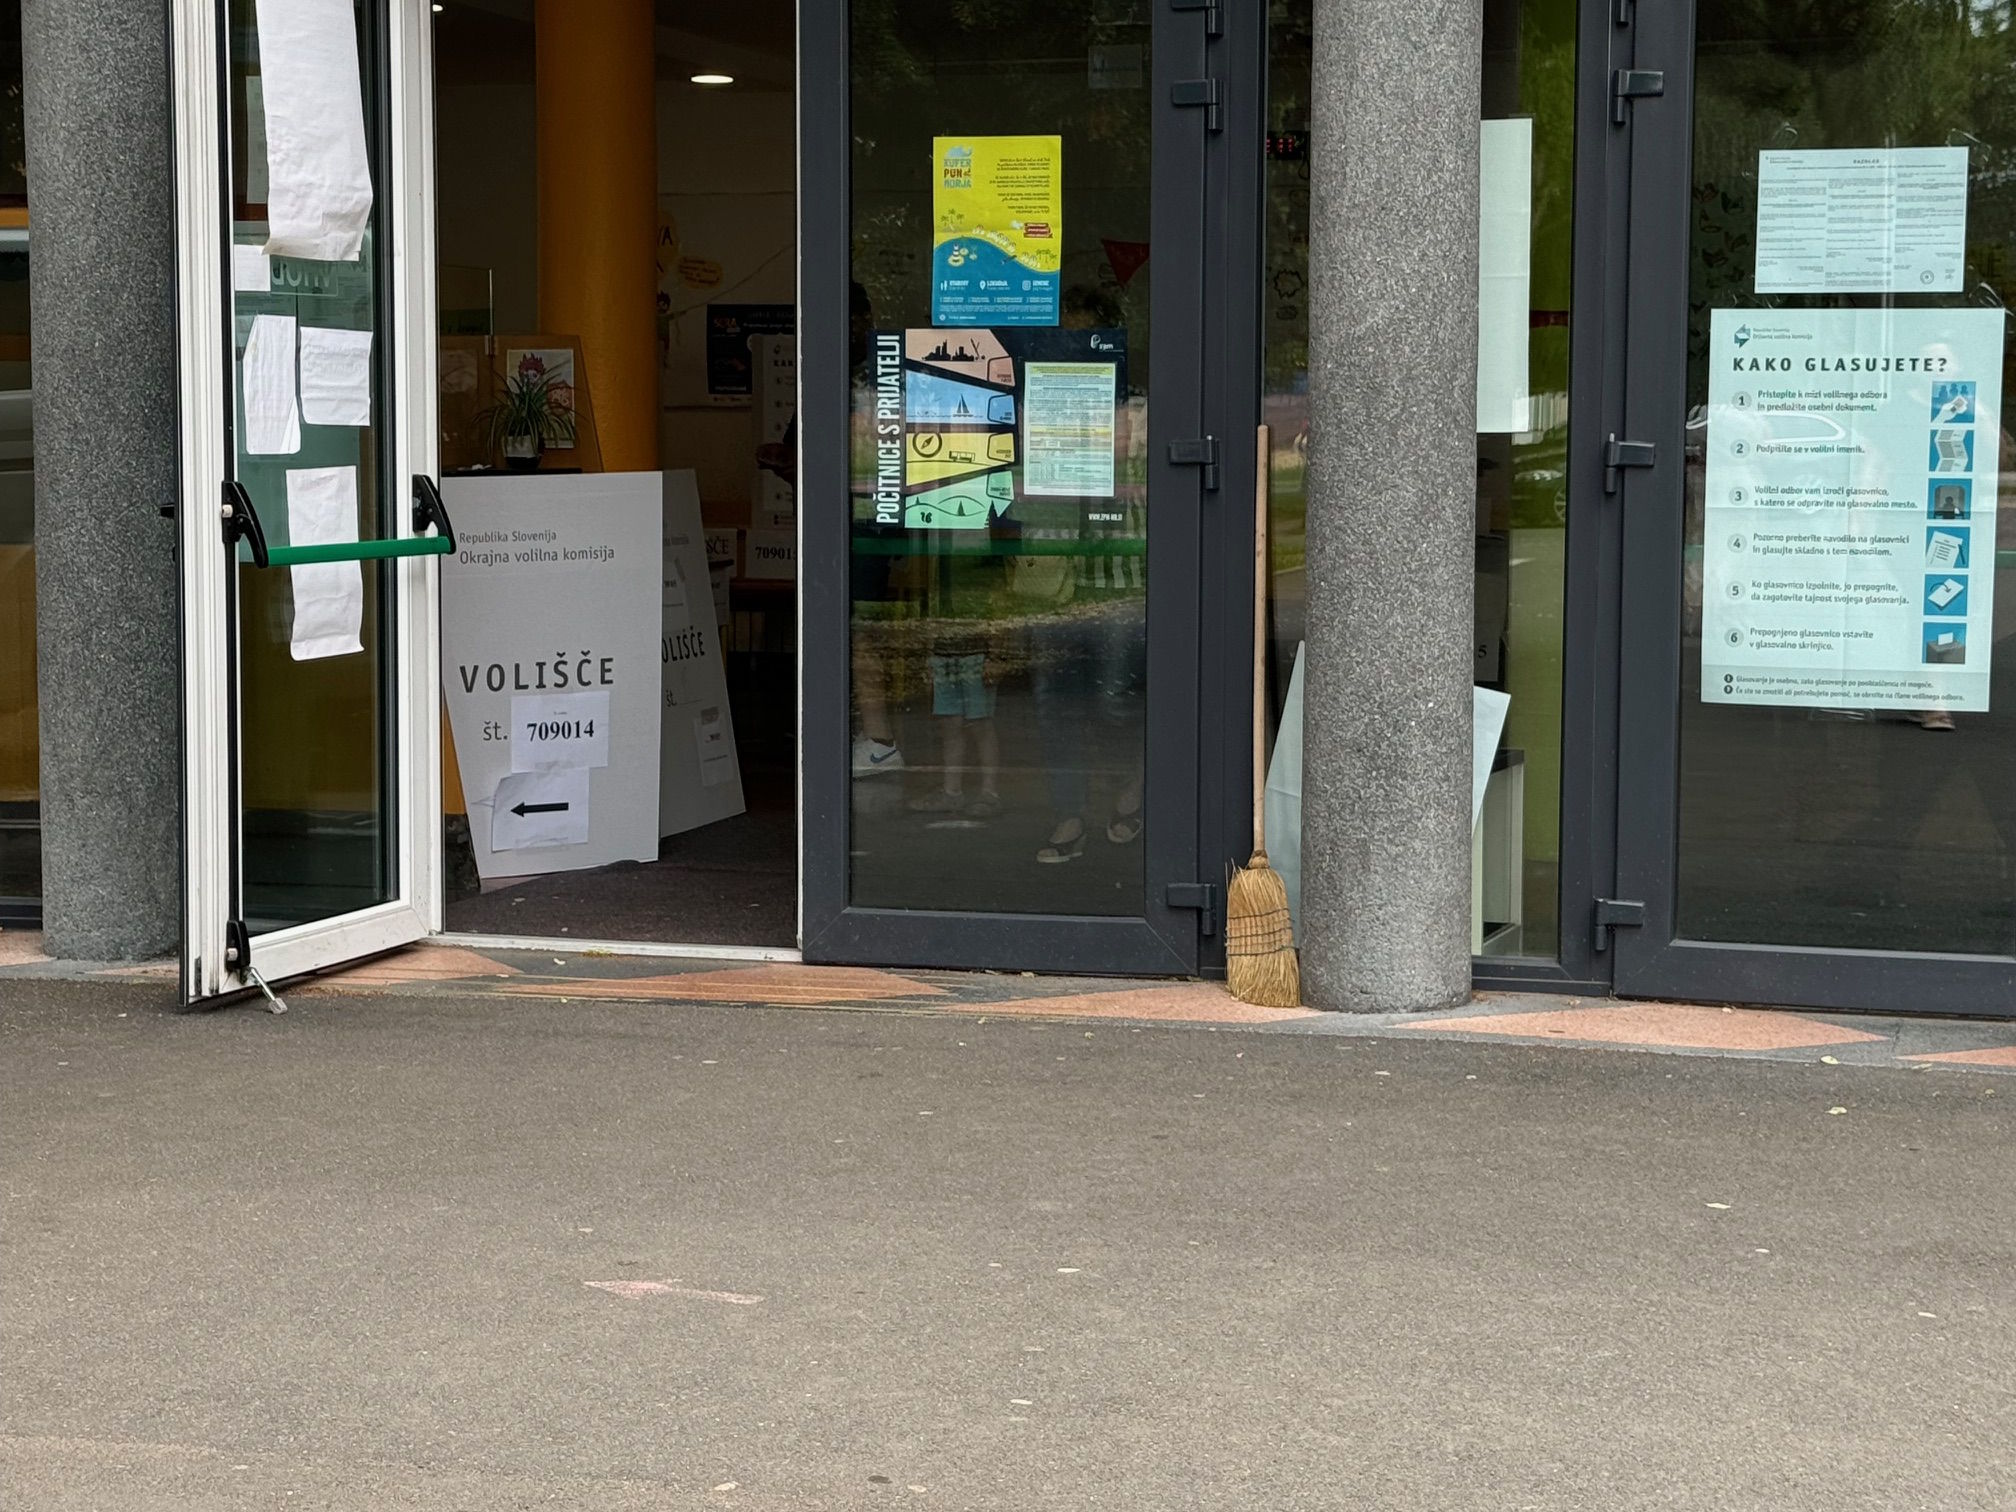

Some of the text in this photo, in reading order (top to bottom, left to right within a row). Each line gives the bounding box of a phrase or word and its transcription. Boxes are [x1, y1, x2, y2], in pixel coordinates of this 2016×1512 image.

[1733, 357, 1948, 372] KAKO GLASUJETE?
[1738, 389, 1887, 406] 1 Pristopite k mizi volilnega odbora
[1757, 402, 1765, 411] in
[1807, 402, 1833, 411] osebni
[1835, 402, 1877, 411] dokument.
[873, 334, 901, 524] POČITNICE S PRIJATELJI
[1736, 443, 1744, 454] 2
[1793, 445, 1802, 453] se
[1804, 445, 1809, 453] v
[1810, 443, 1835, 453] volilni
[1836, 443, 1865, 454] imenik.
[1734, 485, 1889, 502] 3 Volilni odbor vam izroči glasovnico,
[1760, 498, 1785, 507] katero
[1796, 498, 1834, 509] odpravite
[1836, 500, 1846, 508] na
[1847, 499, 1889, 510] glasovalno
[1890, 500, 1917, 509] mesto.
[459, 530, 557, 545] Republika Slovenija
[1733, 533, 1910, 549] 4 Pozorno preberite navodilo na glasovnici
[459, 545, 615, 567] Okrajna volilna komisija
[1761, 545, 1793, 556] glasujte
[1732, 580, 1899, 596] 5 Ko glasovnico izpolnite, jo prepognite,
[1751, 593, 1909, 606] da zagotovite tajnost svojega glasovanja.
[1730, 627, 1874, 643] 6 Prepognjeno glasovnico vstavite
[661, 625, 705, 664] OLIŠČE
[1755, 640, 1797, 650] glasovalno
[1798, 641, 1834, 652] skrinjico.
[459, 649, 614, 693] VOLIŠČE
[482, 720, 508, 742] št.
[526, 719, 595, 742] 709014
